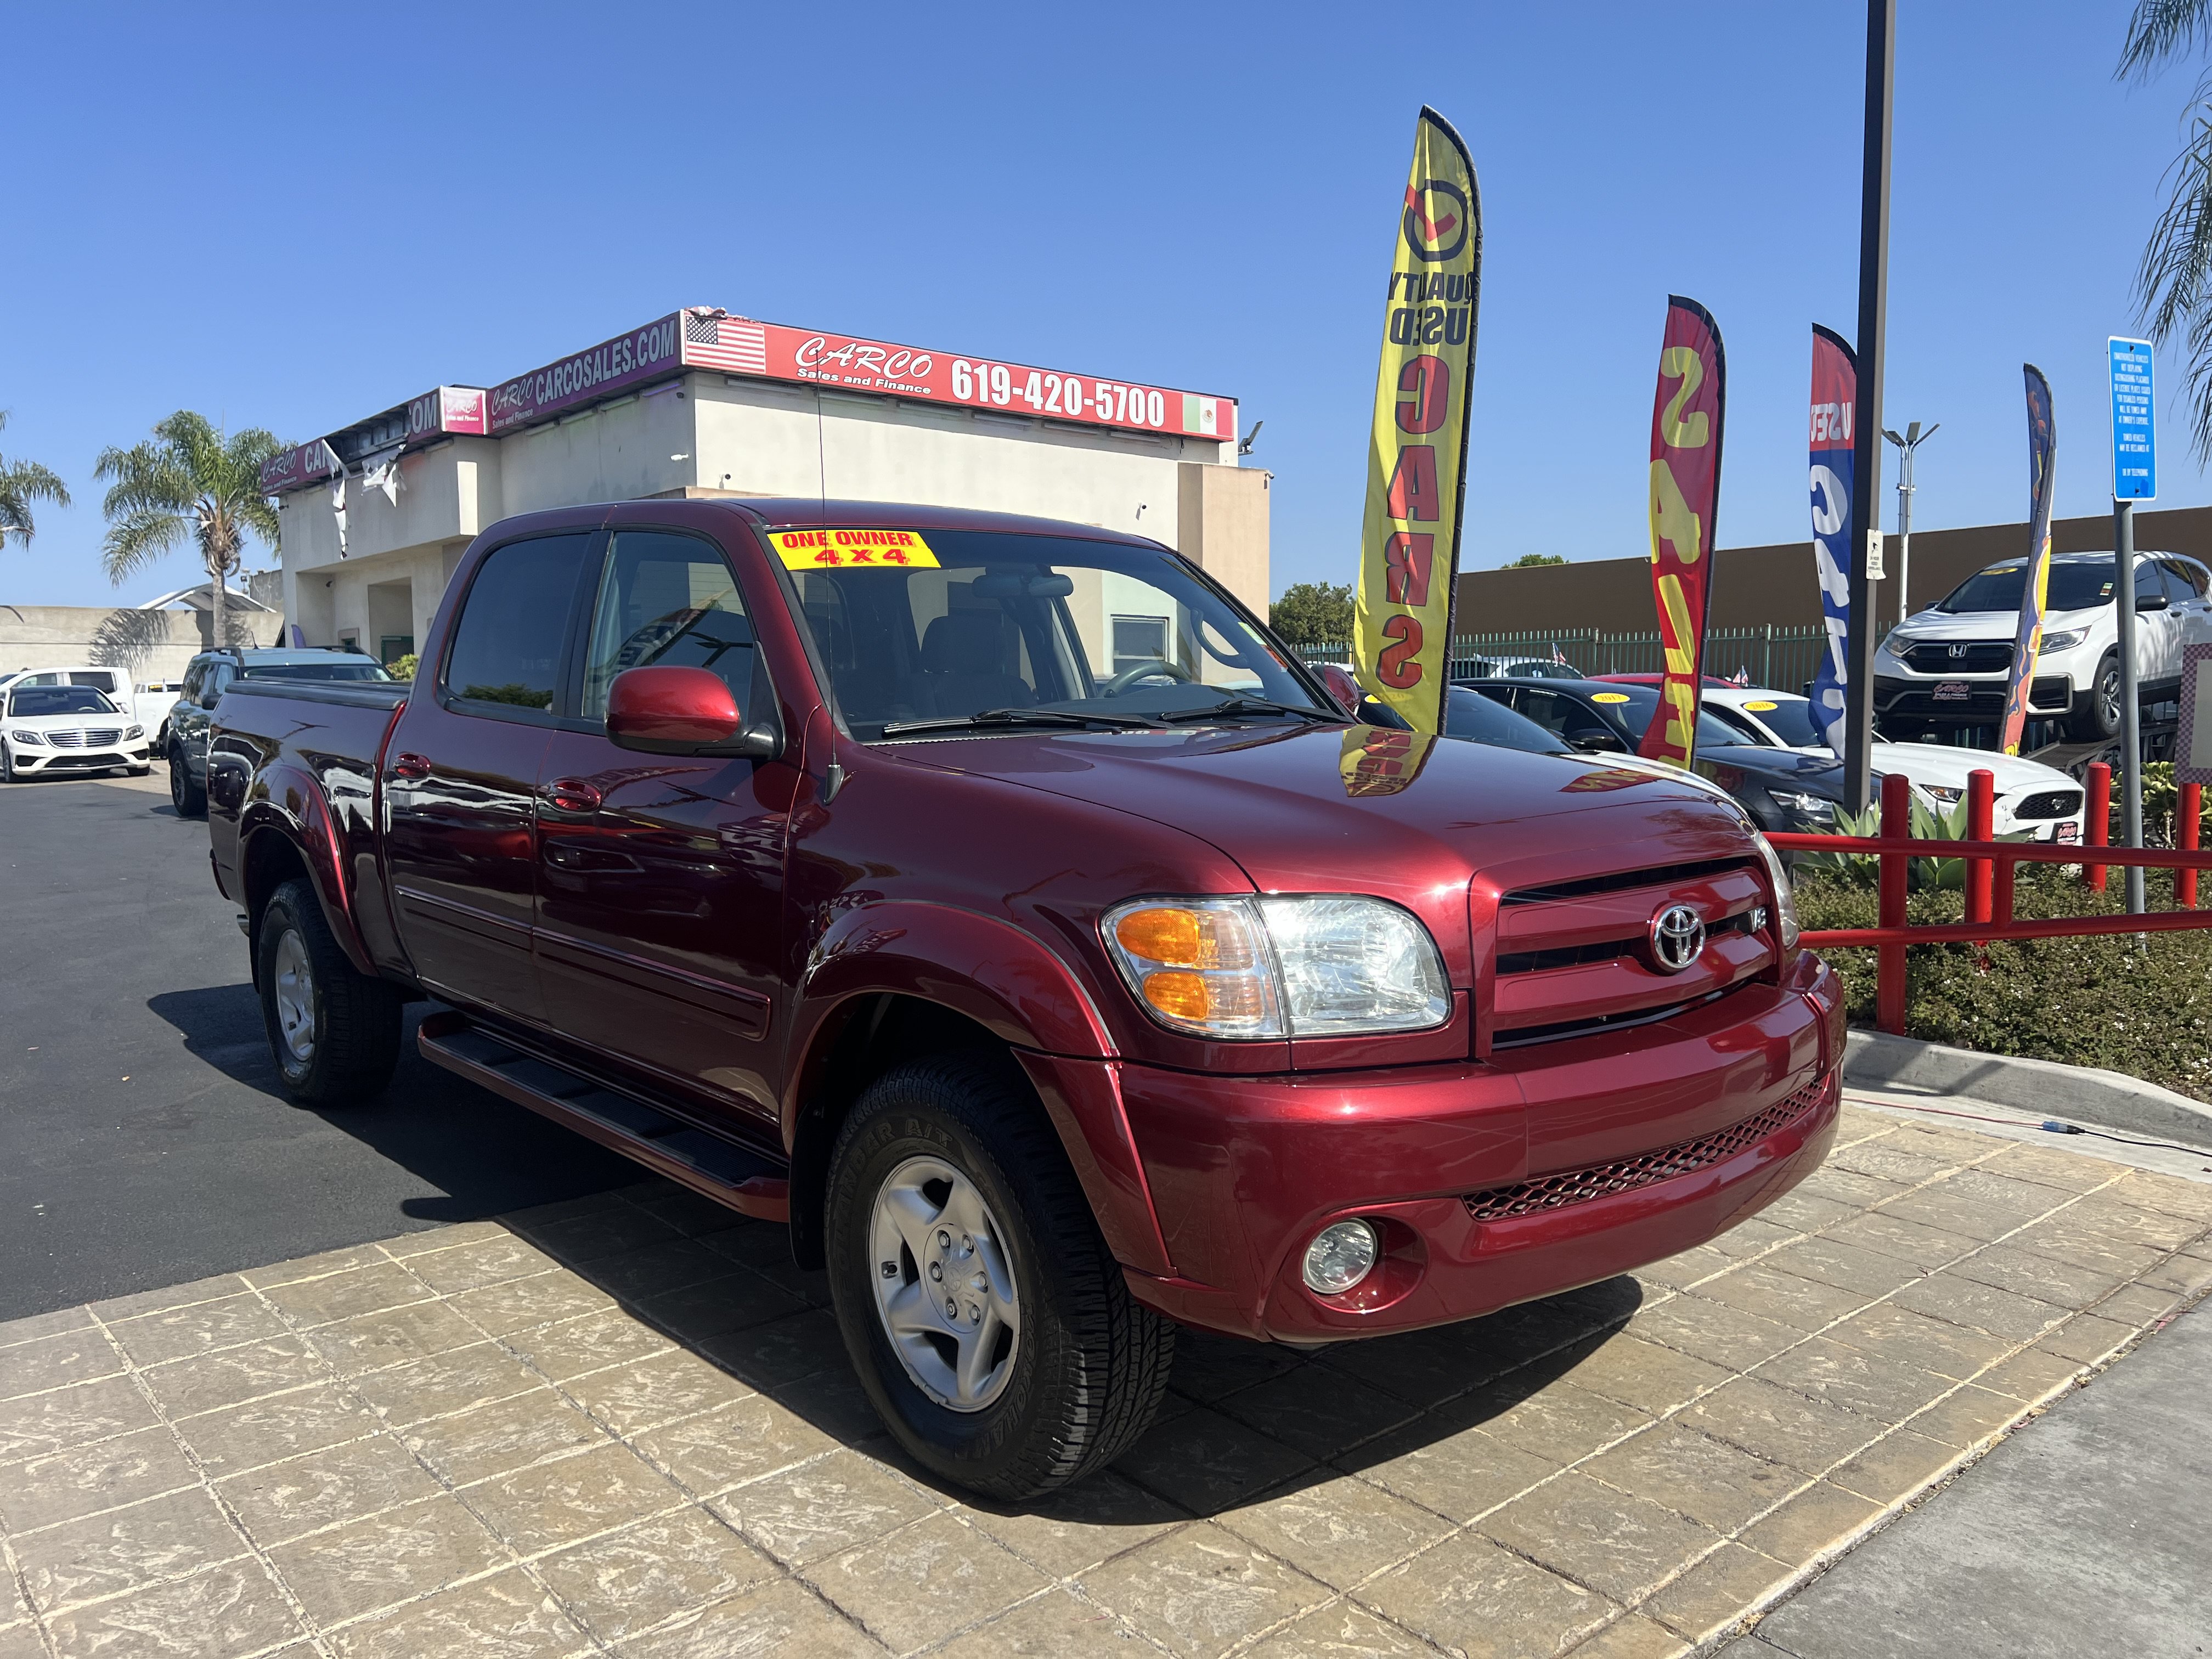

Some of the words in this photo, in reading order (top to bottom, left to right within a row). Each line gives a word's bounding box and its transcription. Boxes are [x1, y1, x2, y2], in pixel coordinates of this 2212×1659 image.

[535, 319, 675, 406] CARCOSALES.COM
[795, 336, 933, 379] CARCO
[492, 376, 533, 416] CARCO
[797, 367, 839, 381] Sales
[843, 375, 871, 386] and
[875, 377, 932, 394] Finance
[951, 359, 1165, 428] 619-420-5700
[263, 451, 296, 483] CARCO
[408, 393, 437, 434] OM
[493, 419, 504, 430] Sales
[505, 413, 514, 425] and
[515, 408, 533, 421] Finance
[782, 532, 830, 549] ONE
[835, 531, 916, 548] OWNER
